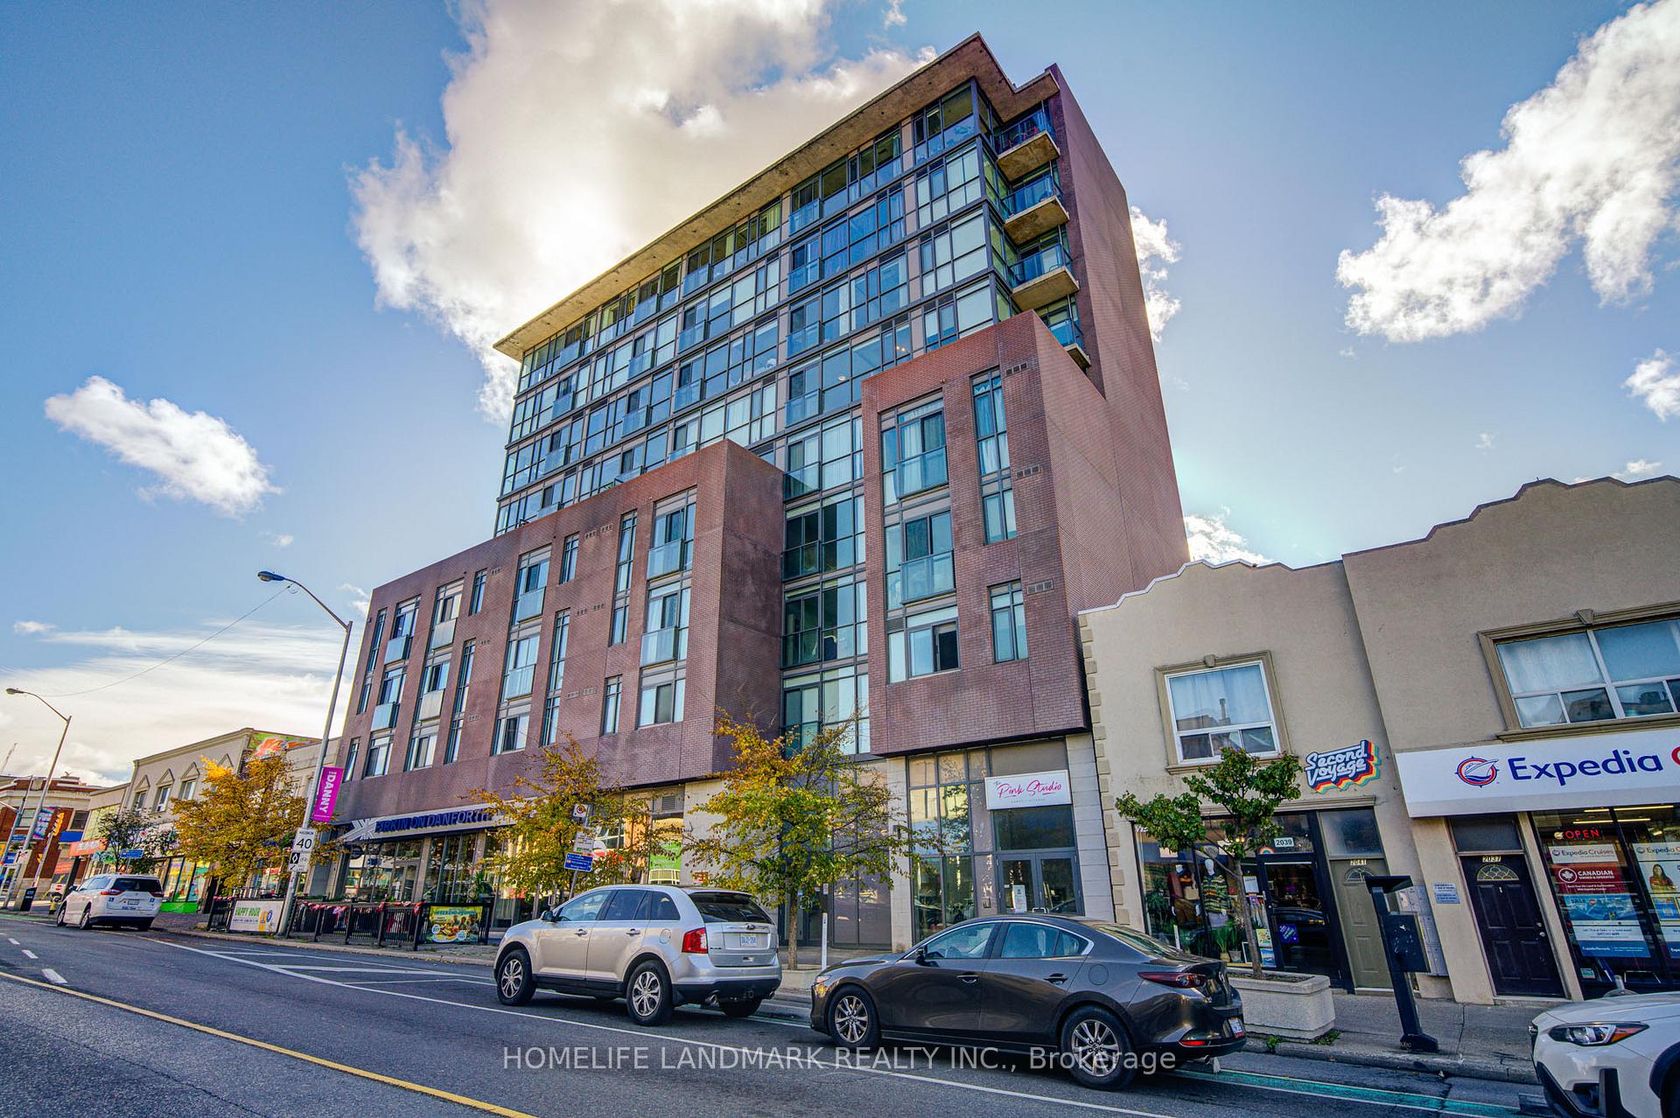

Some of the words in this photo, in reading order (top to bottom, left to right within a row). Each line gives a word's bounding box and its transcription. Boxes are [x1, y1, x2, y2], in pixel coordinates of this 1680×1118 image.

[1305, 740, 1367, 771] Second
[1307, 758, 1366, 786] Voyage
[1508, 749, 1664, 786] Expedia
[319, 774, 337, 814] DANNY
[997, 783, 1025, 799] Pink
[1026, 779, 1063, 796] Studio
[410, 815, 425, 829] ON
[1565, 828, 1600, 840] OPEN
[296, 838, 313, 850] 40
[1561, 848, 1589, 857] Expedia
[1589, 848, 1614, 856] Cruises
[1646, 846, 1676, 854] Expedia
